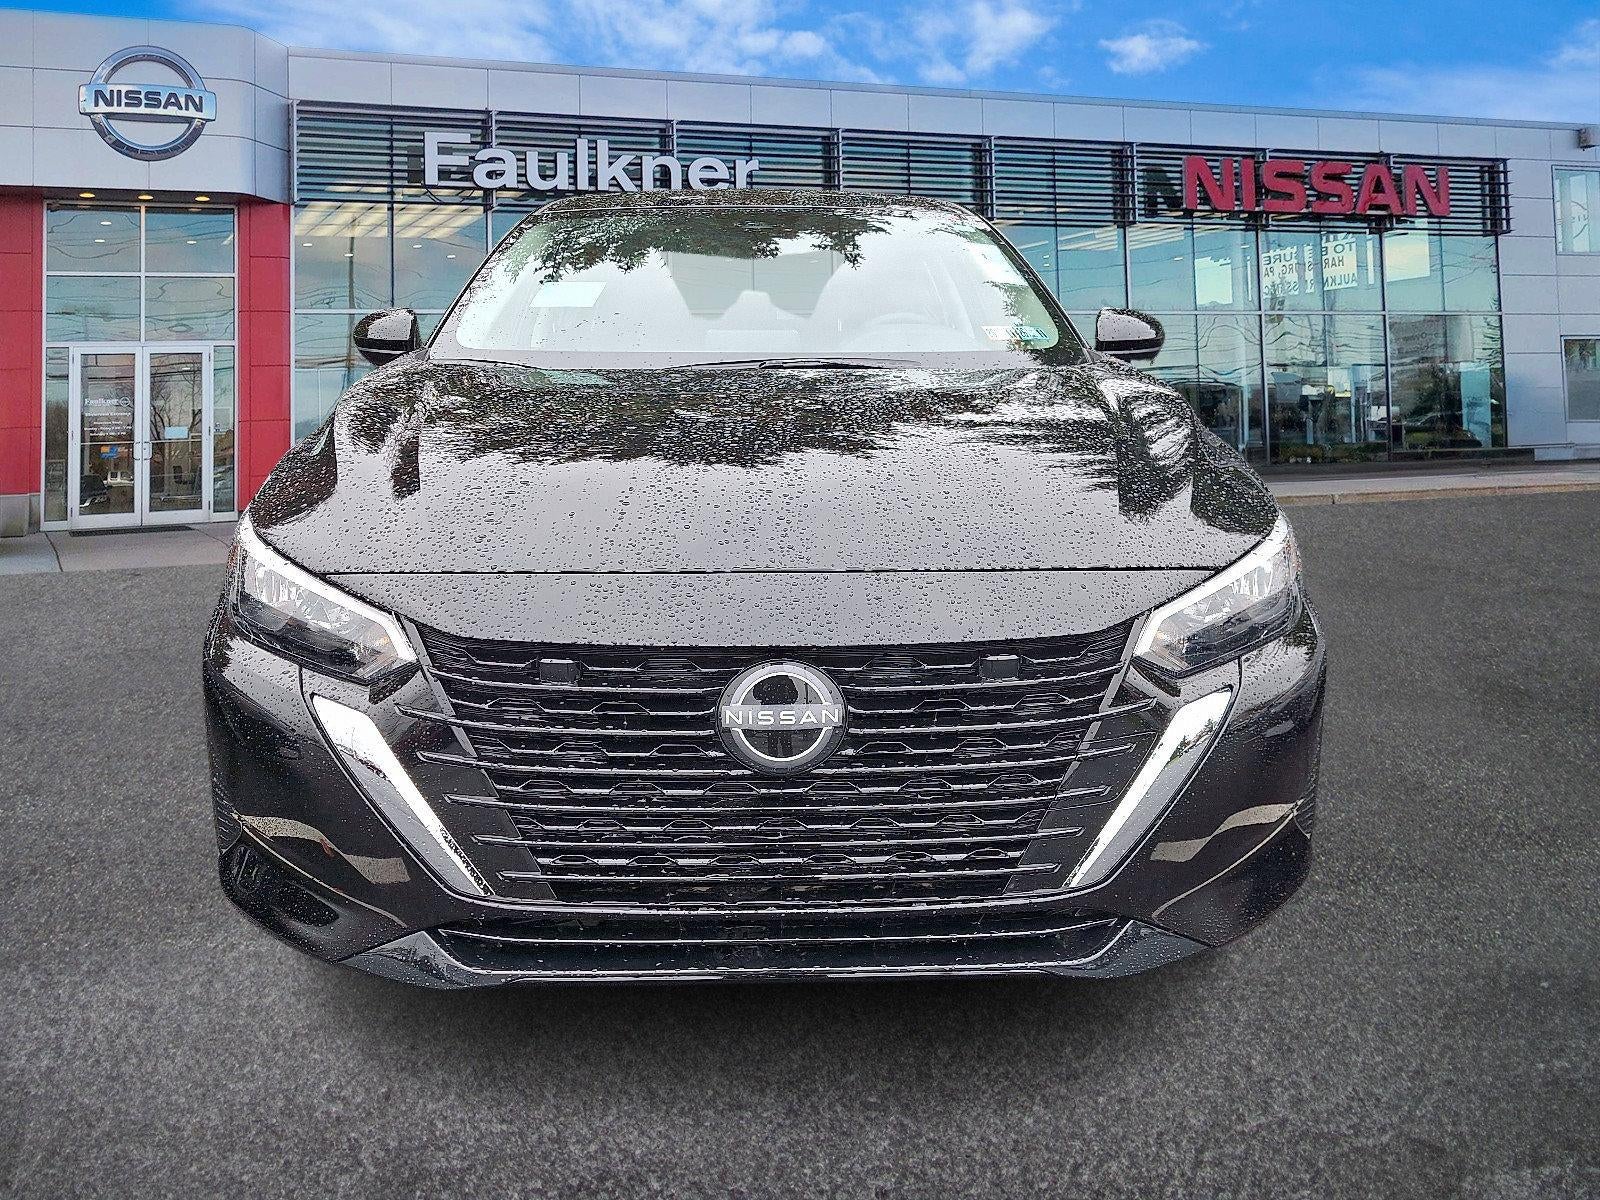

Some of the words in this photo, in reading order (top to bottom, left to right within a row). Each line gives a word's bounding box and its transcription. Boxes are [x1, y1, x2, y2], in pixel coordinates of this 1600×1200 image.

[93, 89, 204, 113] NISSAN
[423, 131, 760, 192] Faulkner
[1182, 154, 1450, 216] NISSAN
[725, 708, 839, 726] NISSAN
